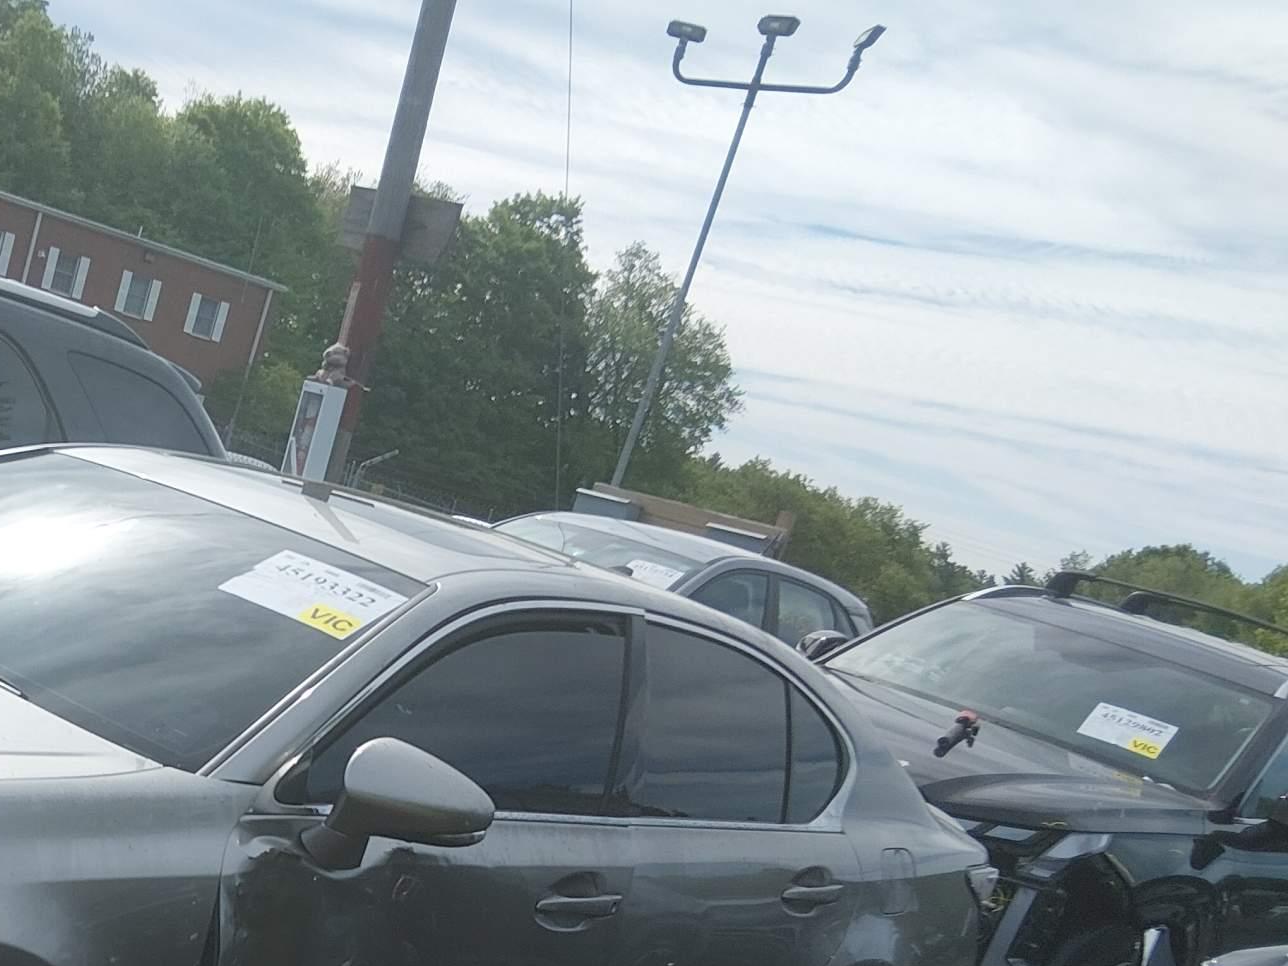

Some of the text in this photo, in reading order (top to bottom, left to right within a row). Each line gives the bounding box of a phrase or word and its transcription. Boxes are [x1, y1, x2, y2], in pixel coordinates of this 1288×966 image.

[275, 563, 377, 608] 45193322
[310, 607, 354, 632] VIC
[1132, 739, 1159, 754] VIC
